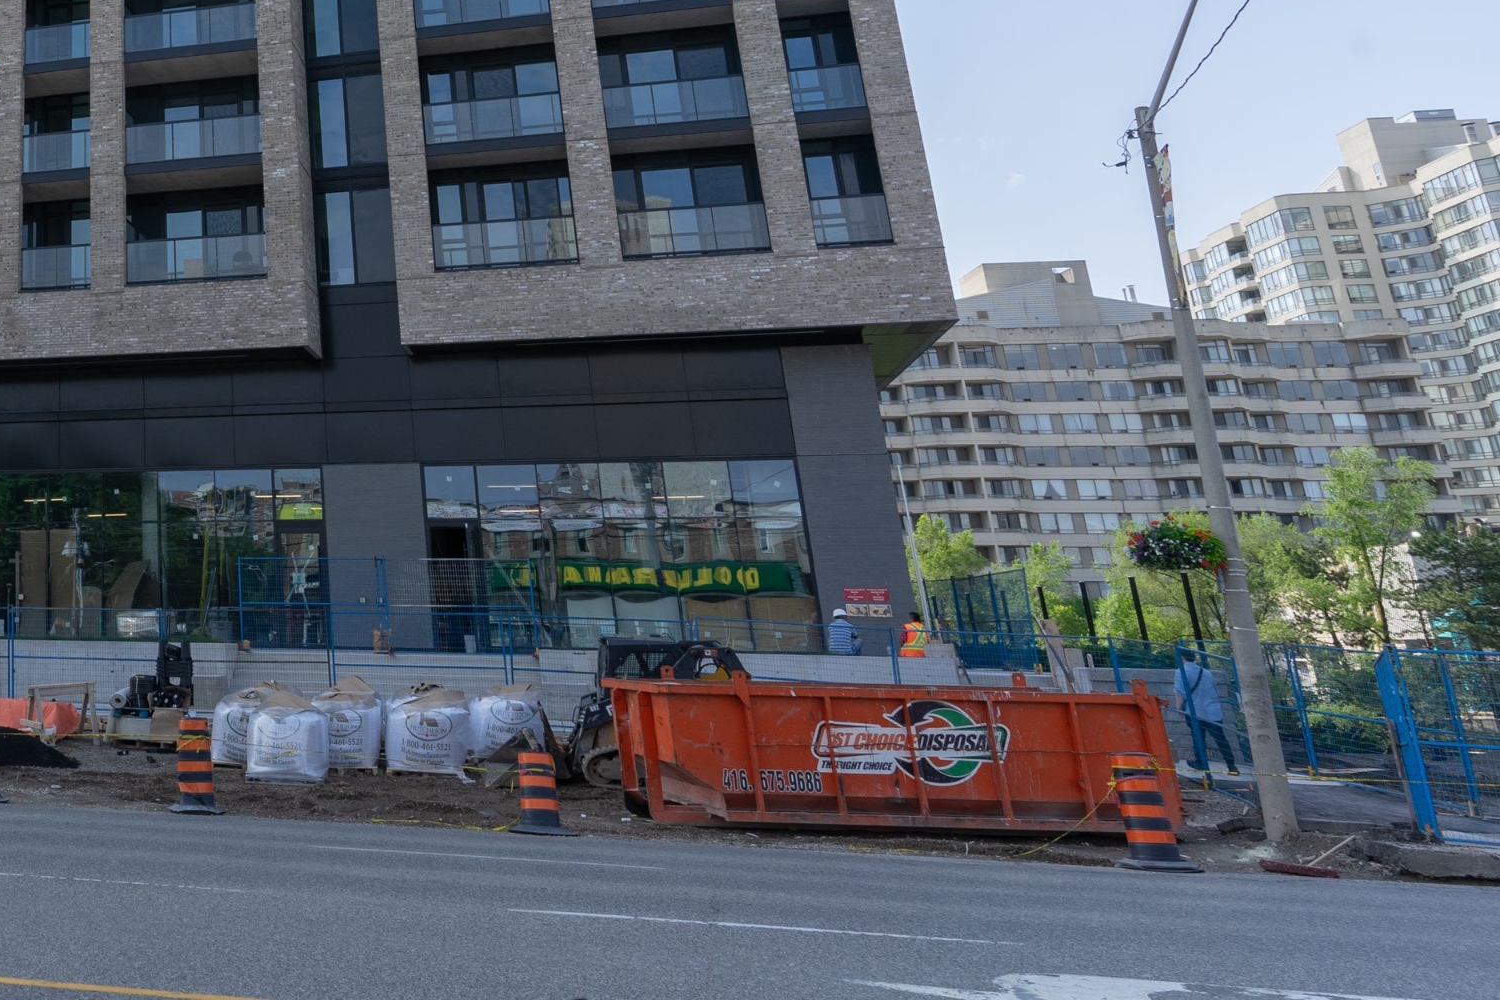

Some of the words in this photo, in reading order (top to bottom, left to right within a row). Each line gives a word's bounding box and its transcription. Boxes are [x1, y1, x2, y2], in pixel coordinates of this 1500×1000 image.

[853, 732, 917, 751] CHOICE
[841, 760, 863, 770] RIGHT
[863, 761, 893, 771] CHOICE
[723, 768, 754, 791] 416.
[760, 769, 822, 792] 675.9686
